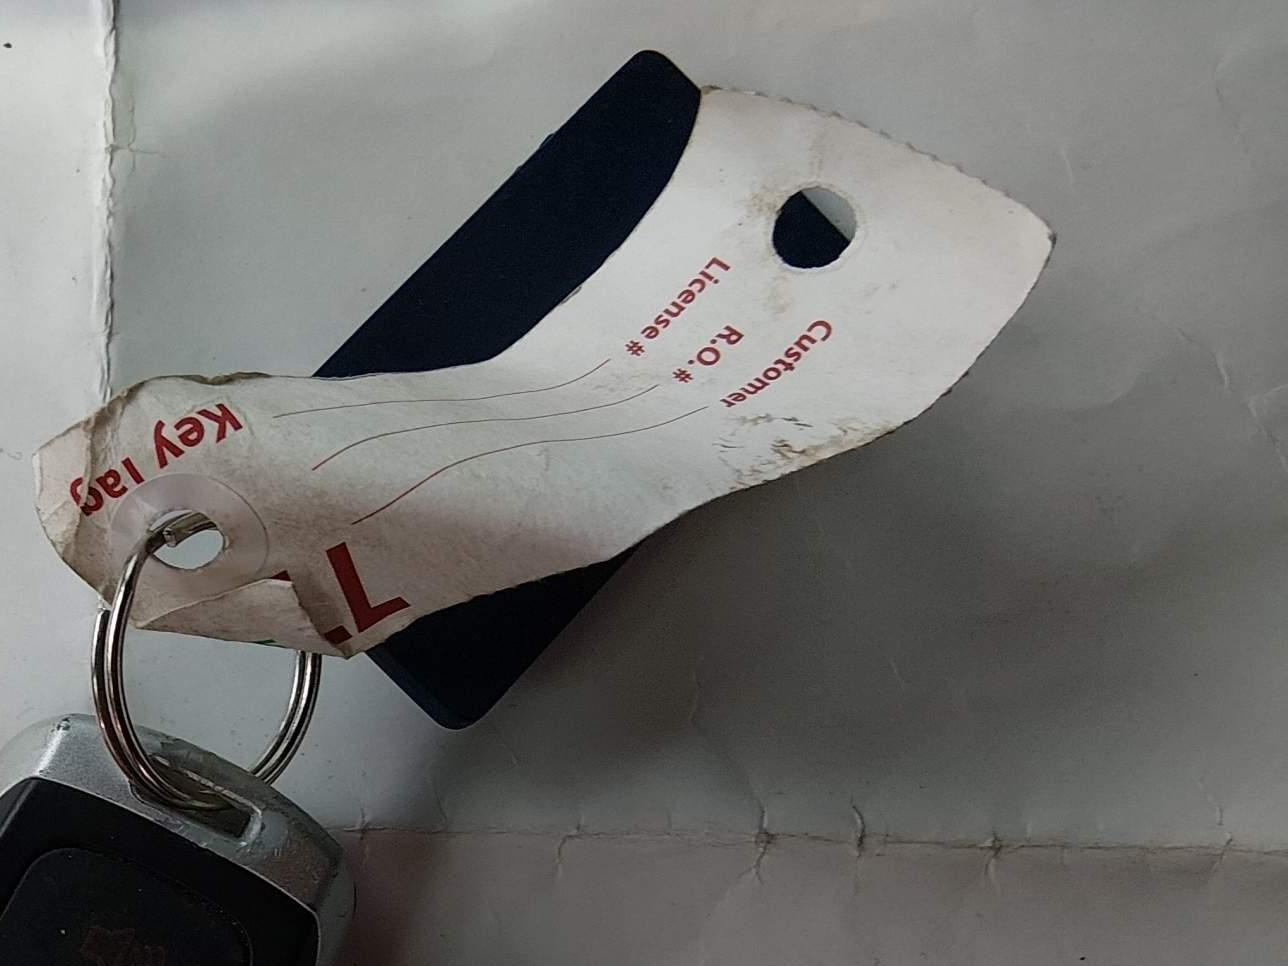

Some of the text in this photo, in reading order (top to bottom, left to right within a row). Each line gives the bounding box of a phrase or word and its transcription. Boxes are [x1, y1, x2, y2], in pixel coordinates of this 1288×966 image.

[625, 256, 731, 357] License #
[672, 324, 745, 384] R.O. #
[720, 318, 834, 408] Customer
[152, 402, 244, 469] Key
